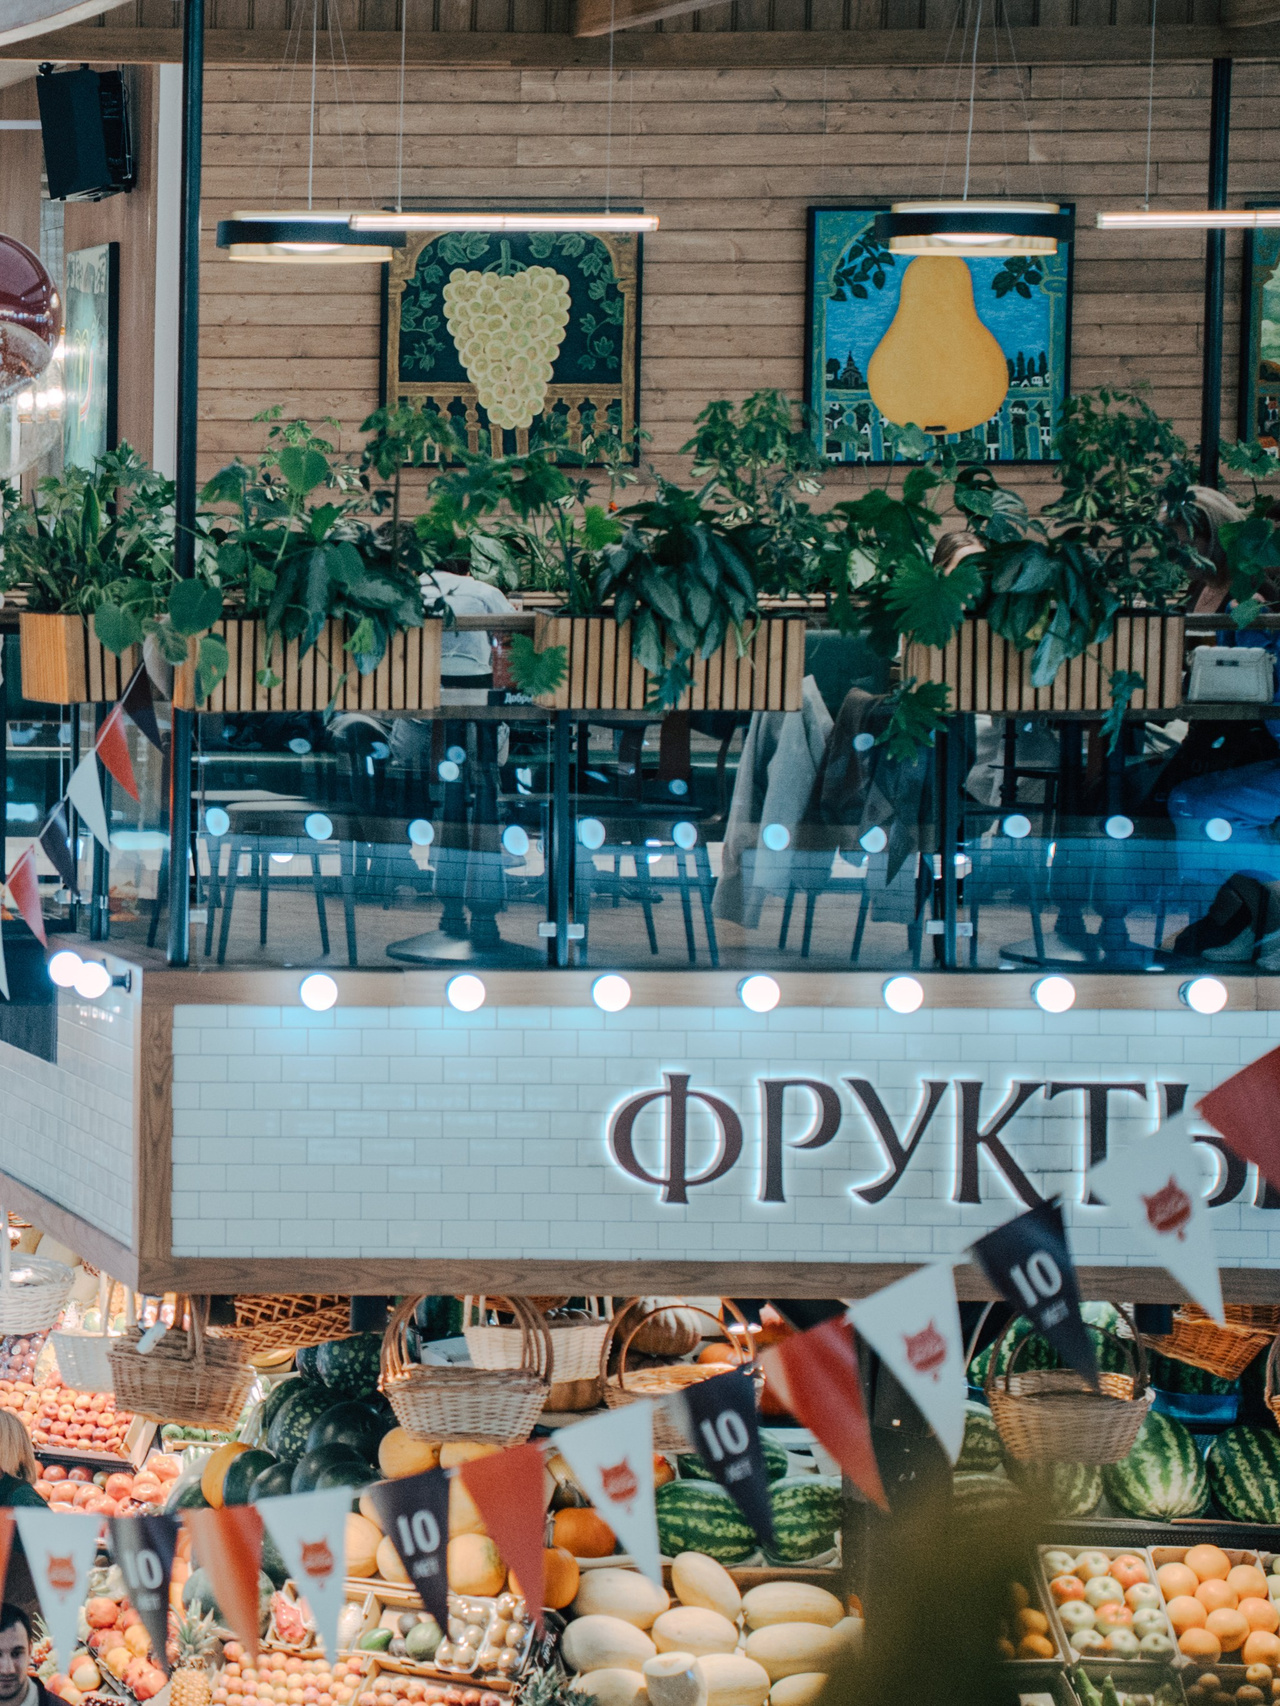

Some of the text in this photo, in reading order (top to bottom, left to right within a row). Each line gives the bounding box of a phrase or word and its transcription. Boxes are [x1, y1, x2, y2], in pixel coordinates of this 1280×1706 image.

[1010, 1250, 1062, 1308] 10
[701, 1410, 749, 1462] 10
[397, 1509, 440, 1556] 10
[123, 1549, 163, 1589] 10
